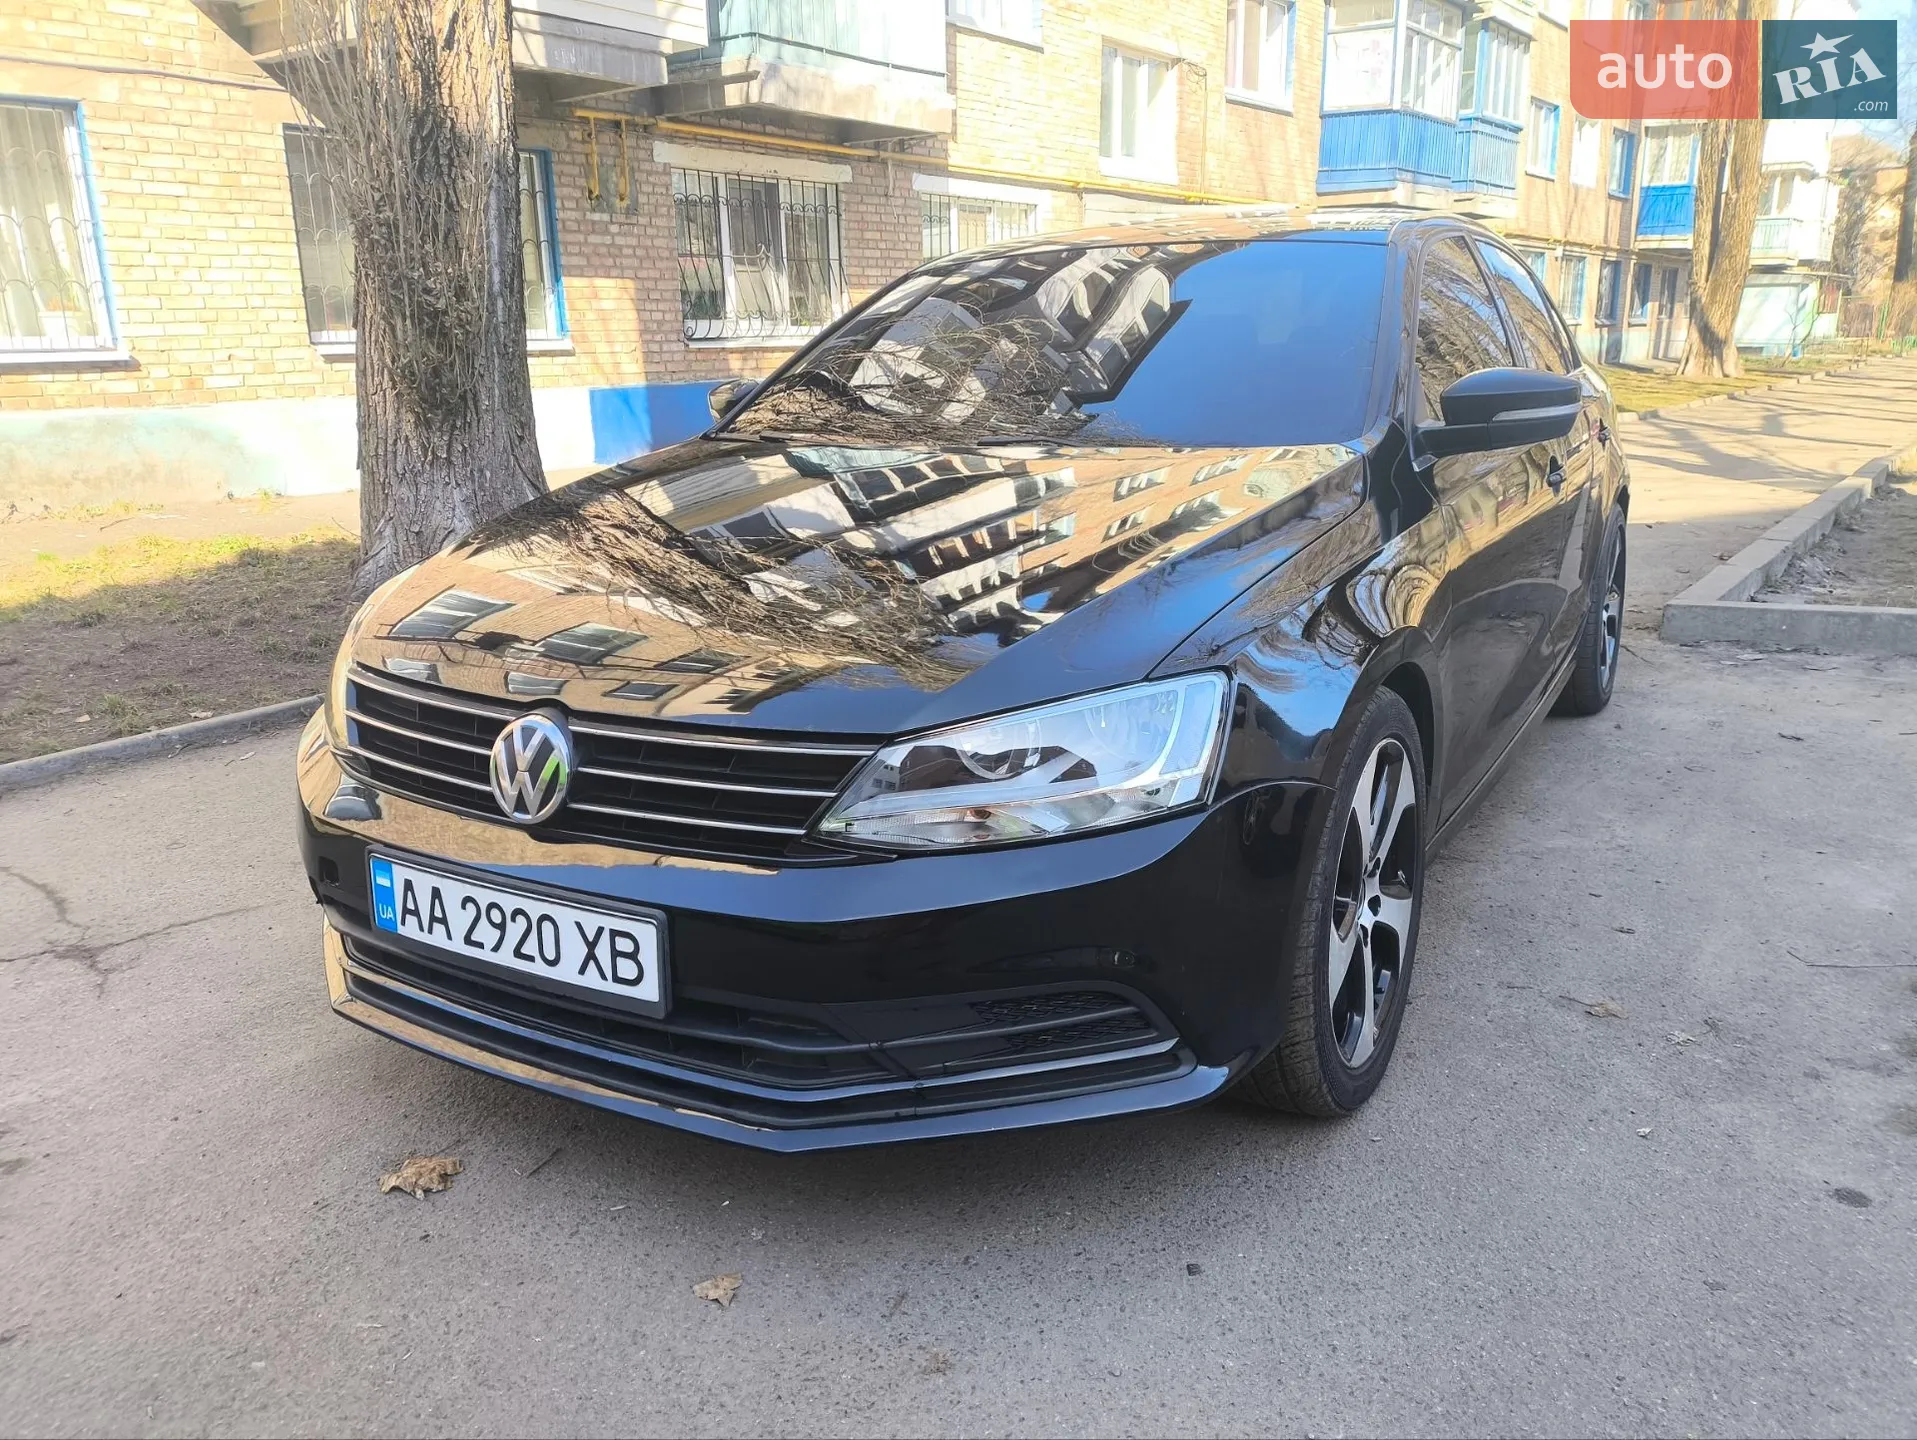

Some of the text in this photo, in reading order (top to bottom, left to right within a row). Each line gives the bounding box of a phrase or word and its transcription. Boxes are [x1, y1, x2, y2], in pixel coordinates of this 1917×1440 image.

[379, 903, 395, 923] UA
[400, 877, 645, 987] AA 2920 XB
